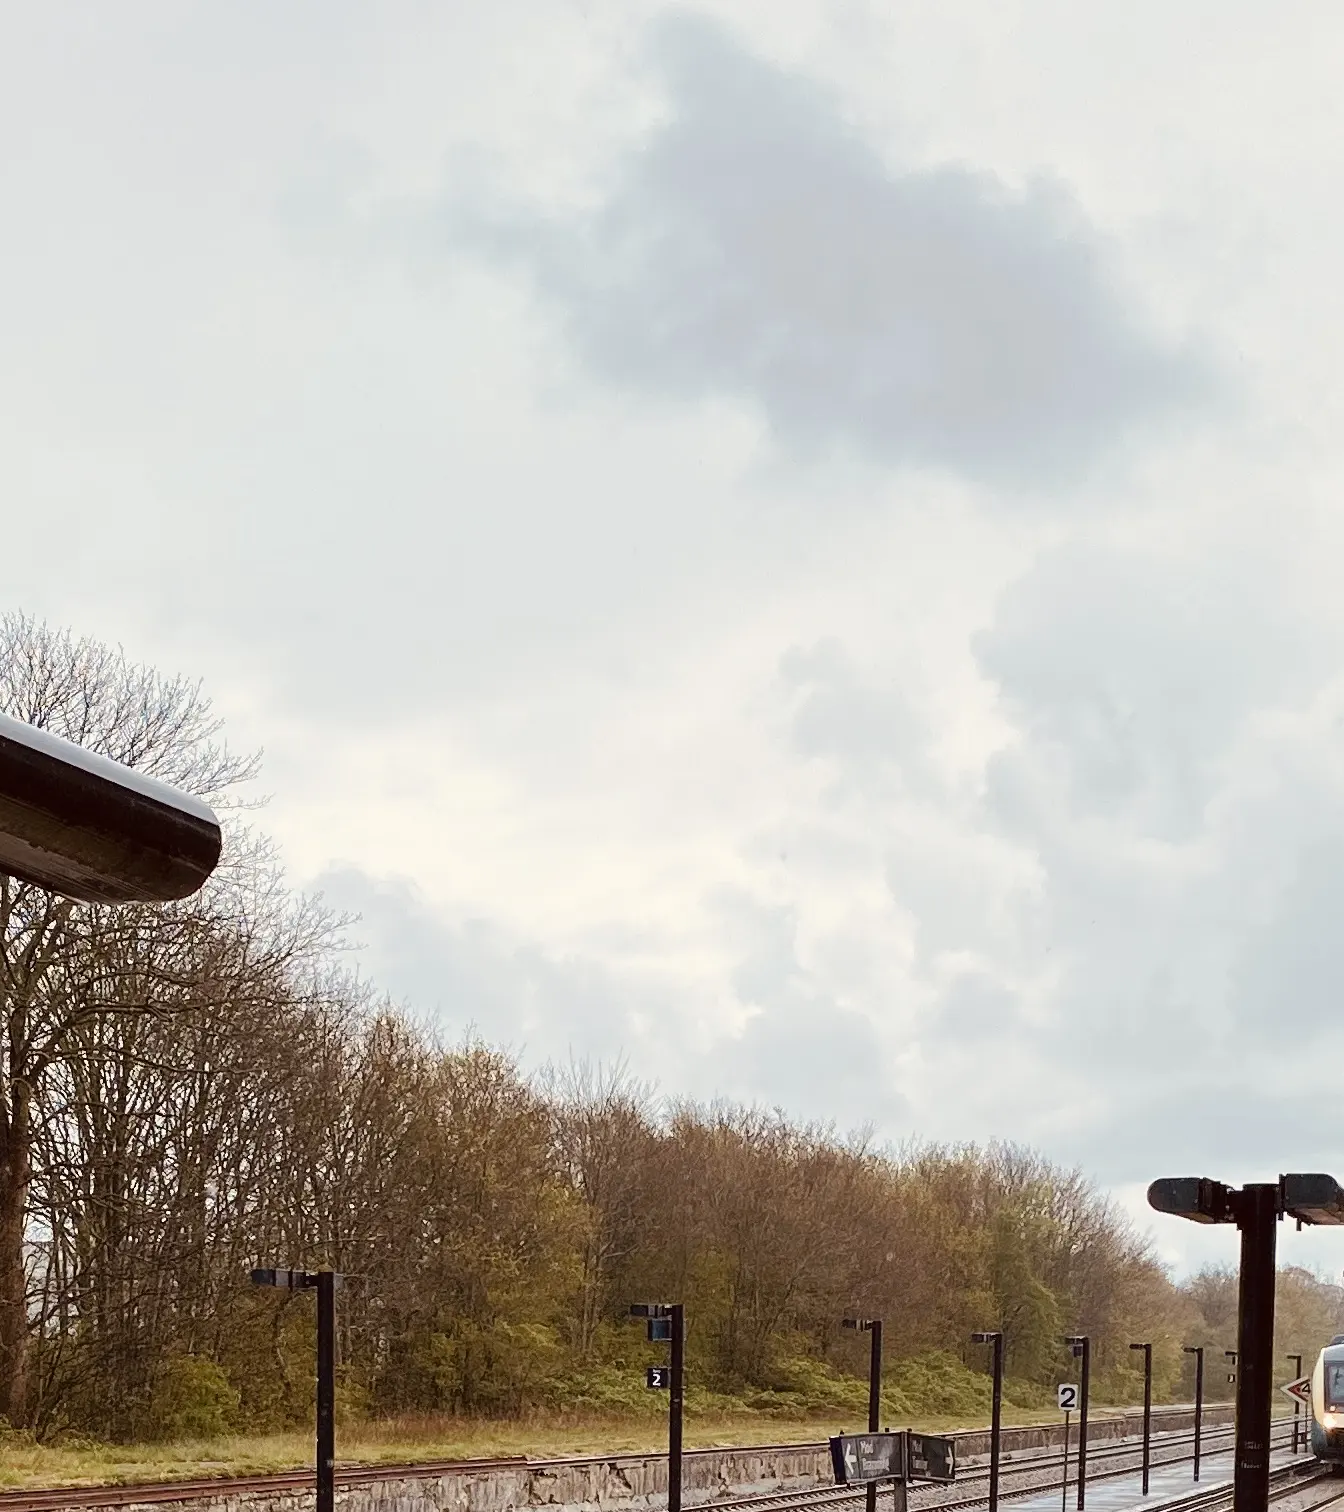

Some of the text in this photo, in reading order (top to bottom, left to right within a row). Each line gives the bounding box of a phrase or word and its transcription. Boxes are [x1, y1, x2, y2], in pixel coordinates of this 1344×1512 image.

[652, 1374, 661, 1386] 2
[1302, 1383, 1311, 1394] 4
[1061, 1387, 1075, 1407] 2
